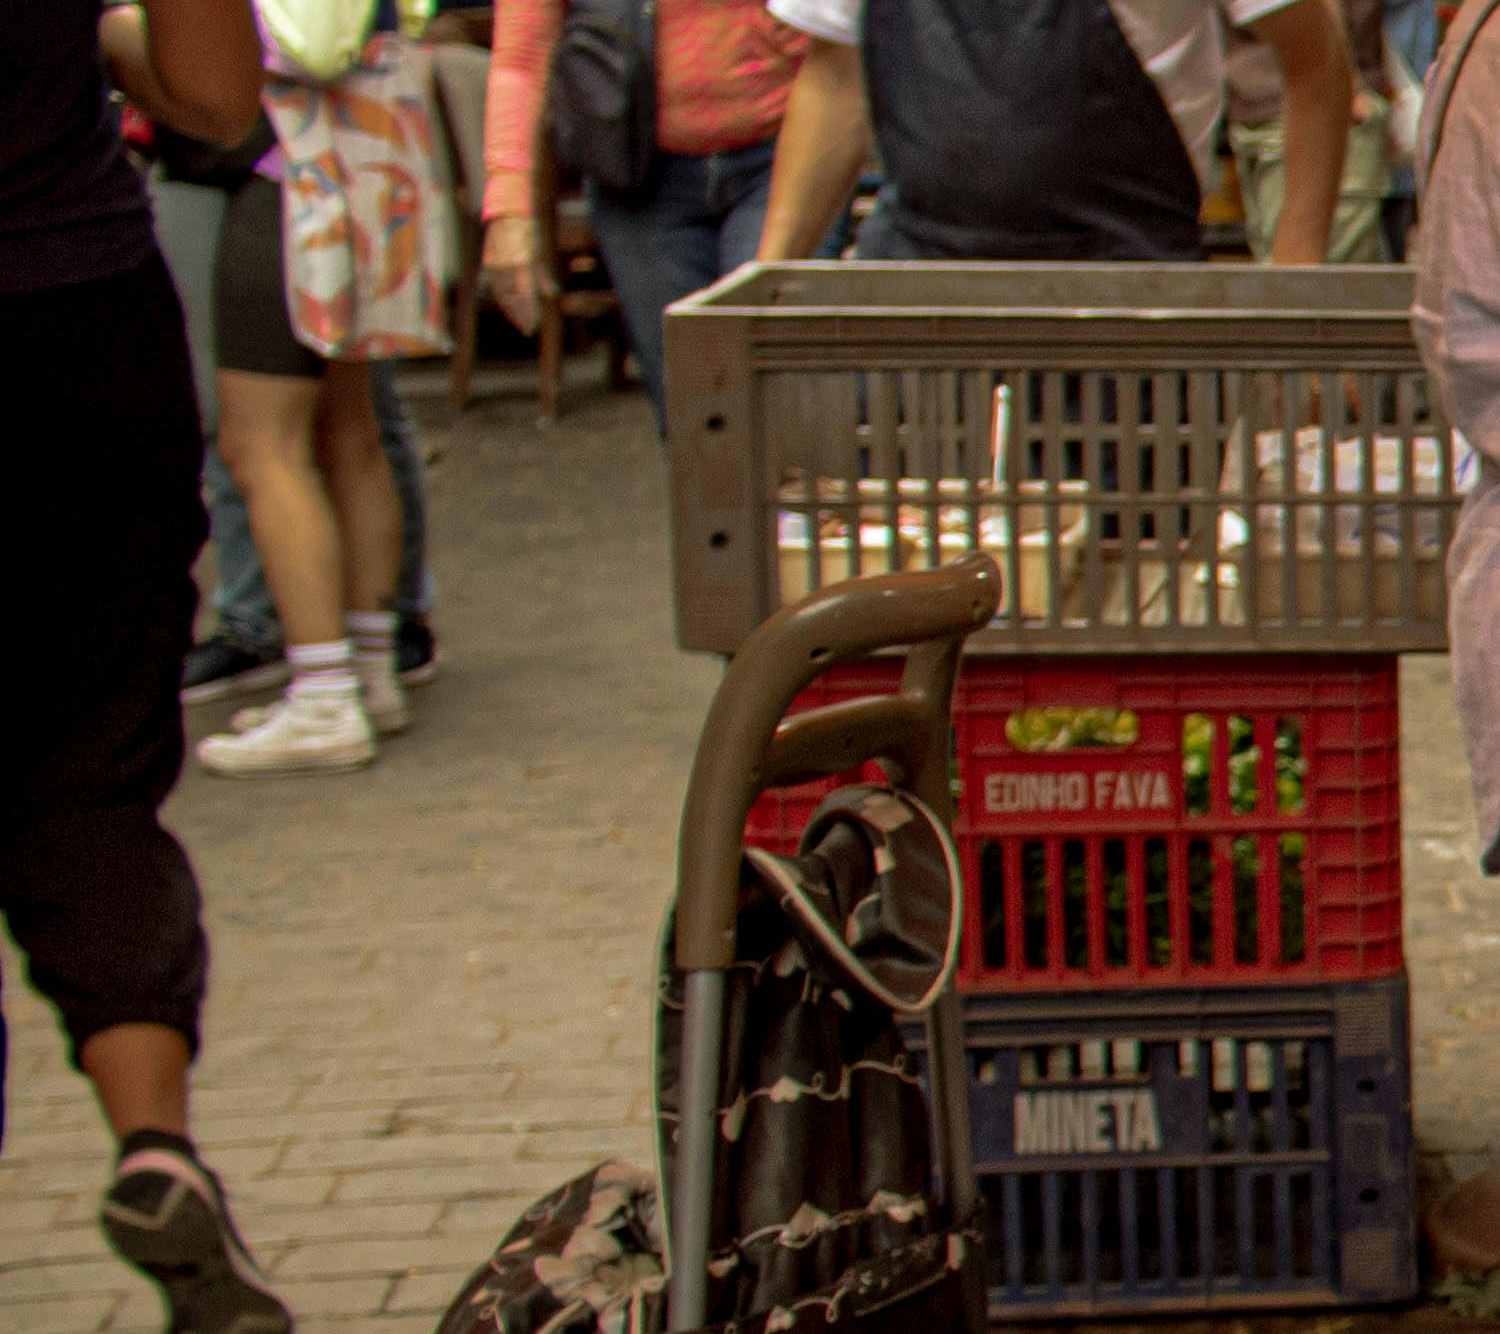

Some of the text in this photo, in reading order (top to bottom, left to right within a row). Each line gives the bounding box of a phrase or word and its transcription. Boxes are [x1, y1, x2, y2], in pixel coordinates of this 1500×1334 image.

[984, 771, 1172, 813] EDINHO FAVA
[1013, 1088, 1162, 1155] MINETA
